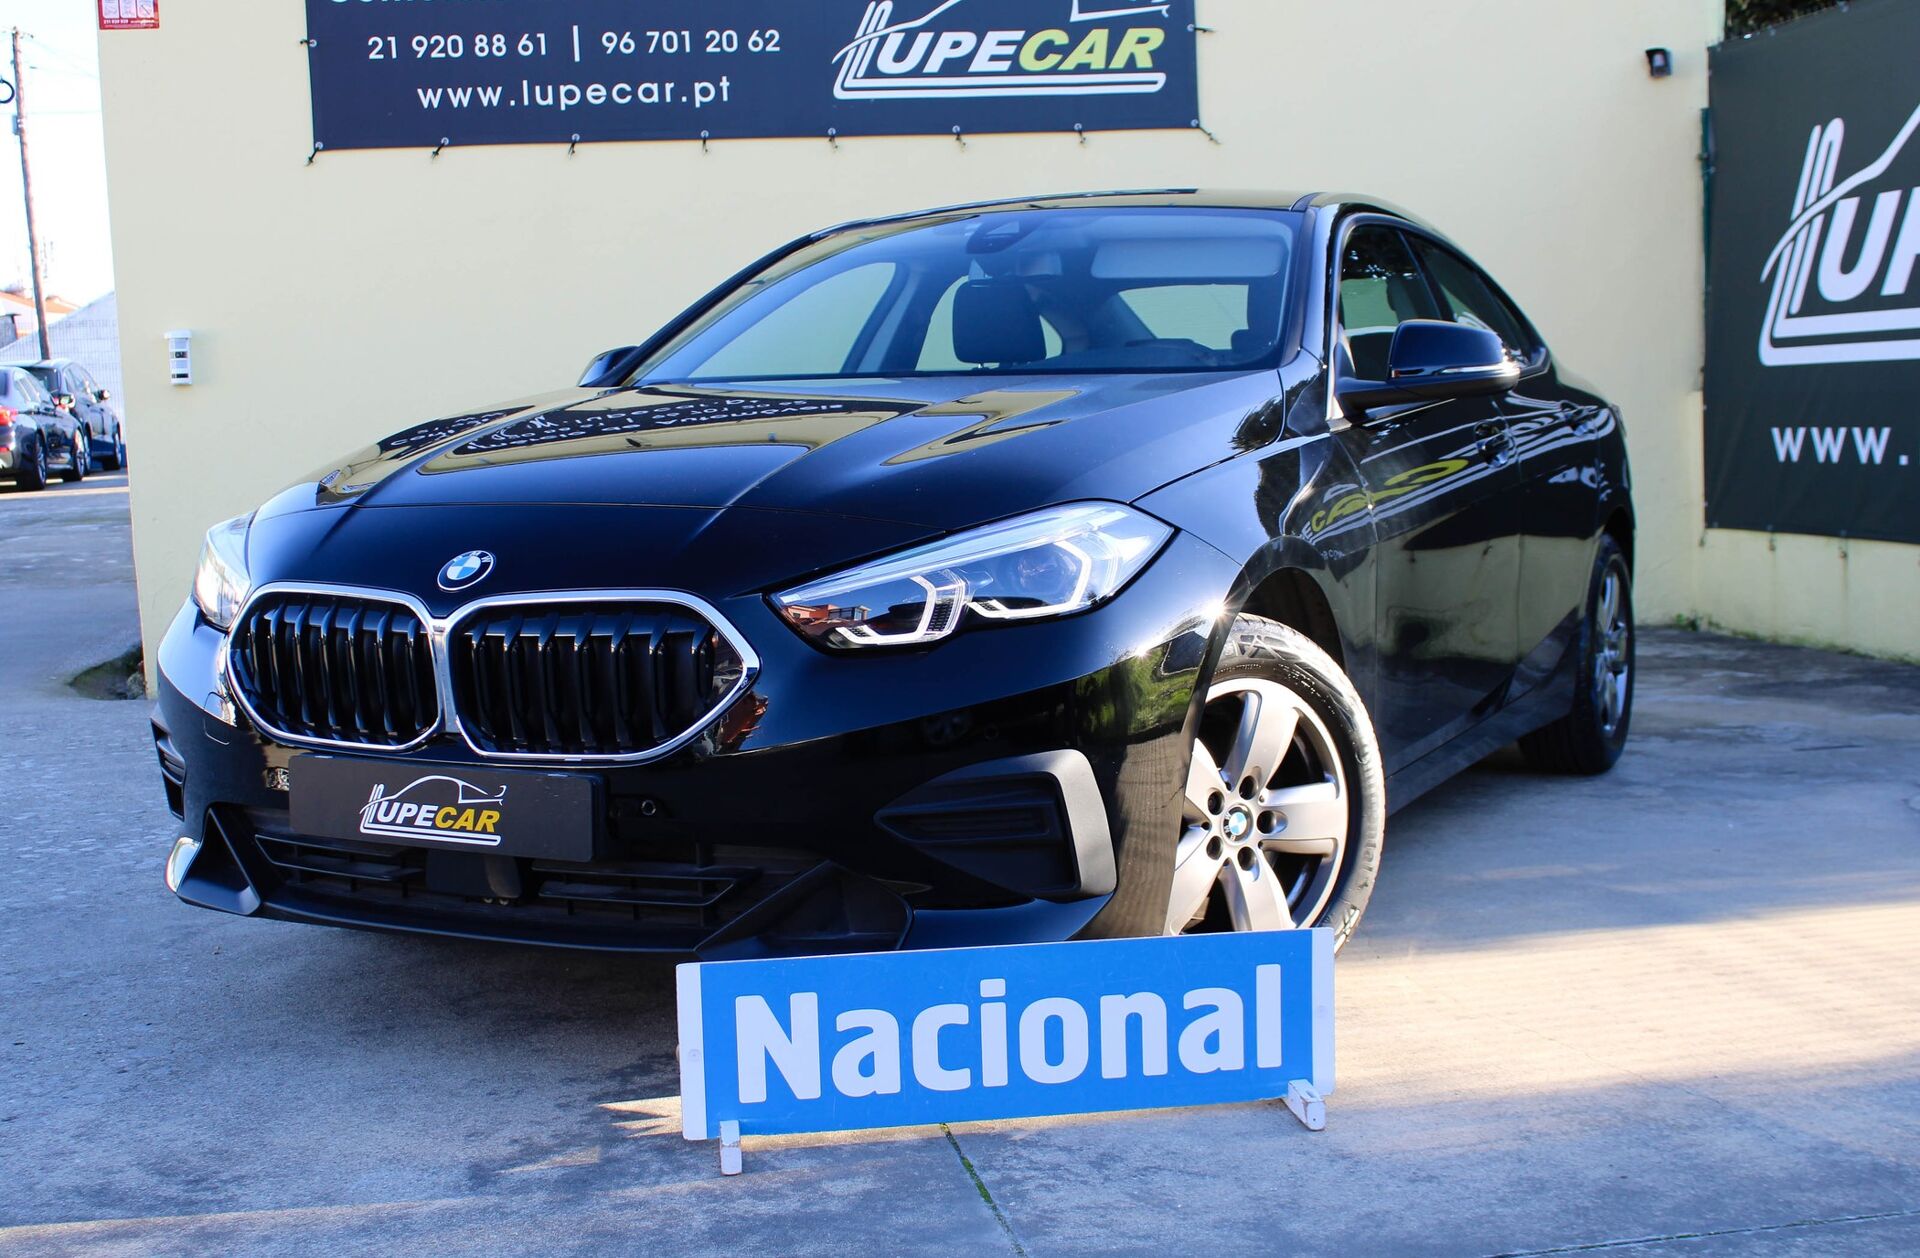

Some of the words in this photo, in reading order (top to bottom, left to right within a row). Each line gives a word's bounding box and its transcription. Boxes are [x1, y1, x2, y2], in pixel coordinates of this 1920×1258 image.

[368, 36, 397, 60] 21
[411, 34, 464, 59] 920
[474, 33, 507, 57] 88
[517, 33, 547, 56] 61
[601, 31, 636, 55] 96
[646, 30, 692, 54] 701
[705, 29, 739, 53] 20
[747, 29, 781, 53] 62
[417, 75, 731, 110] www.lupecar.pt
[360, 784, 501, 846] LUPECAR
[735, 963, 1282, 1104] Nacional
